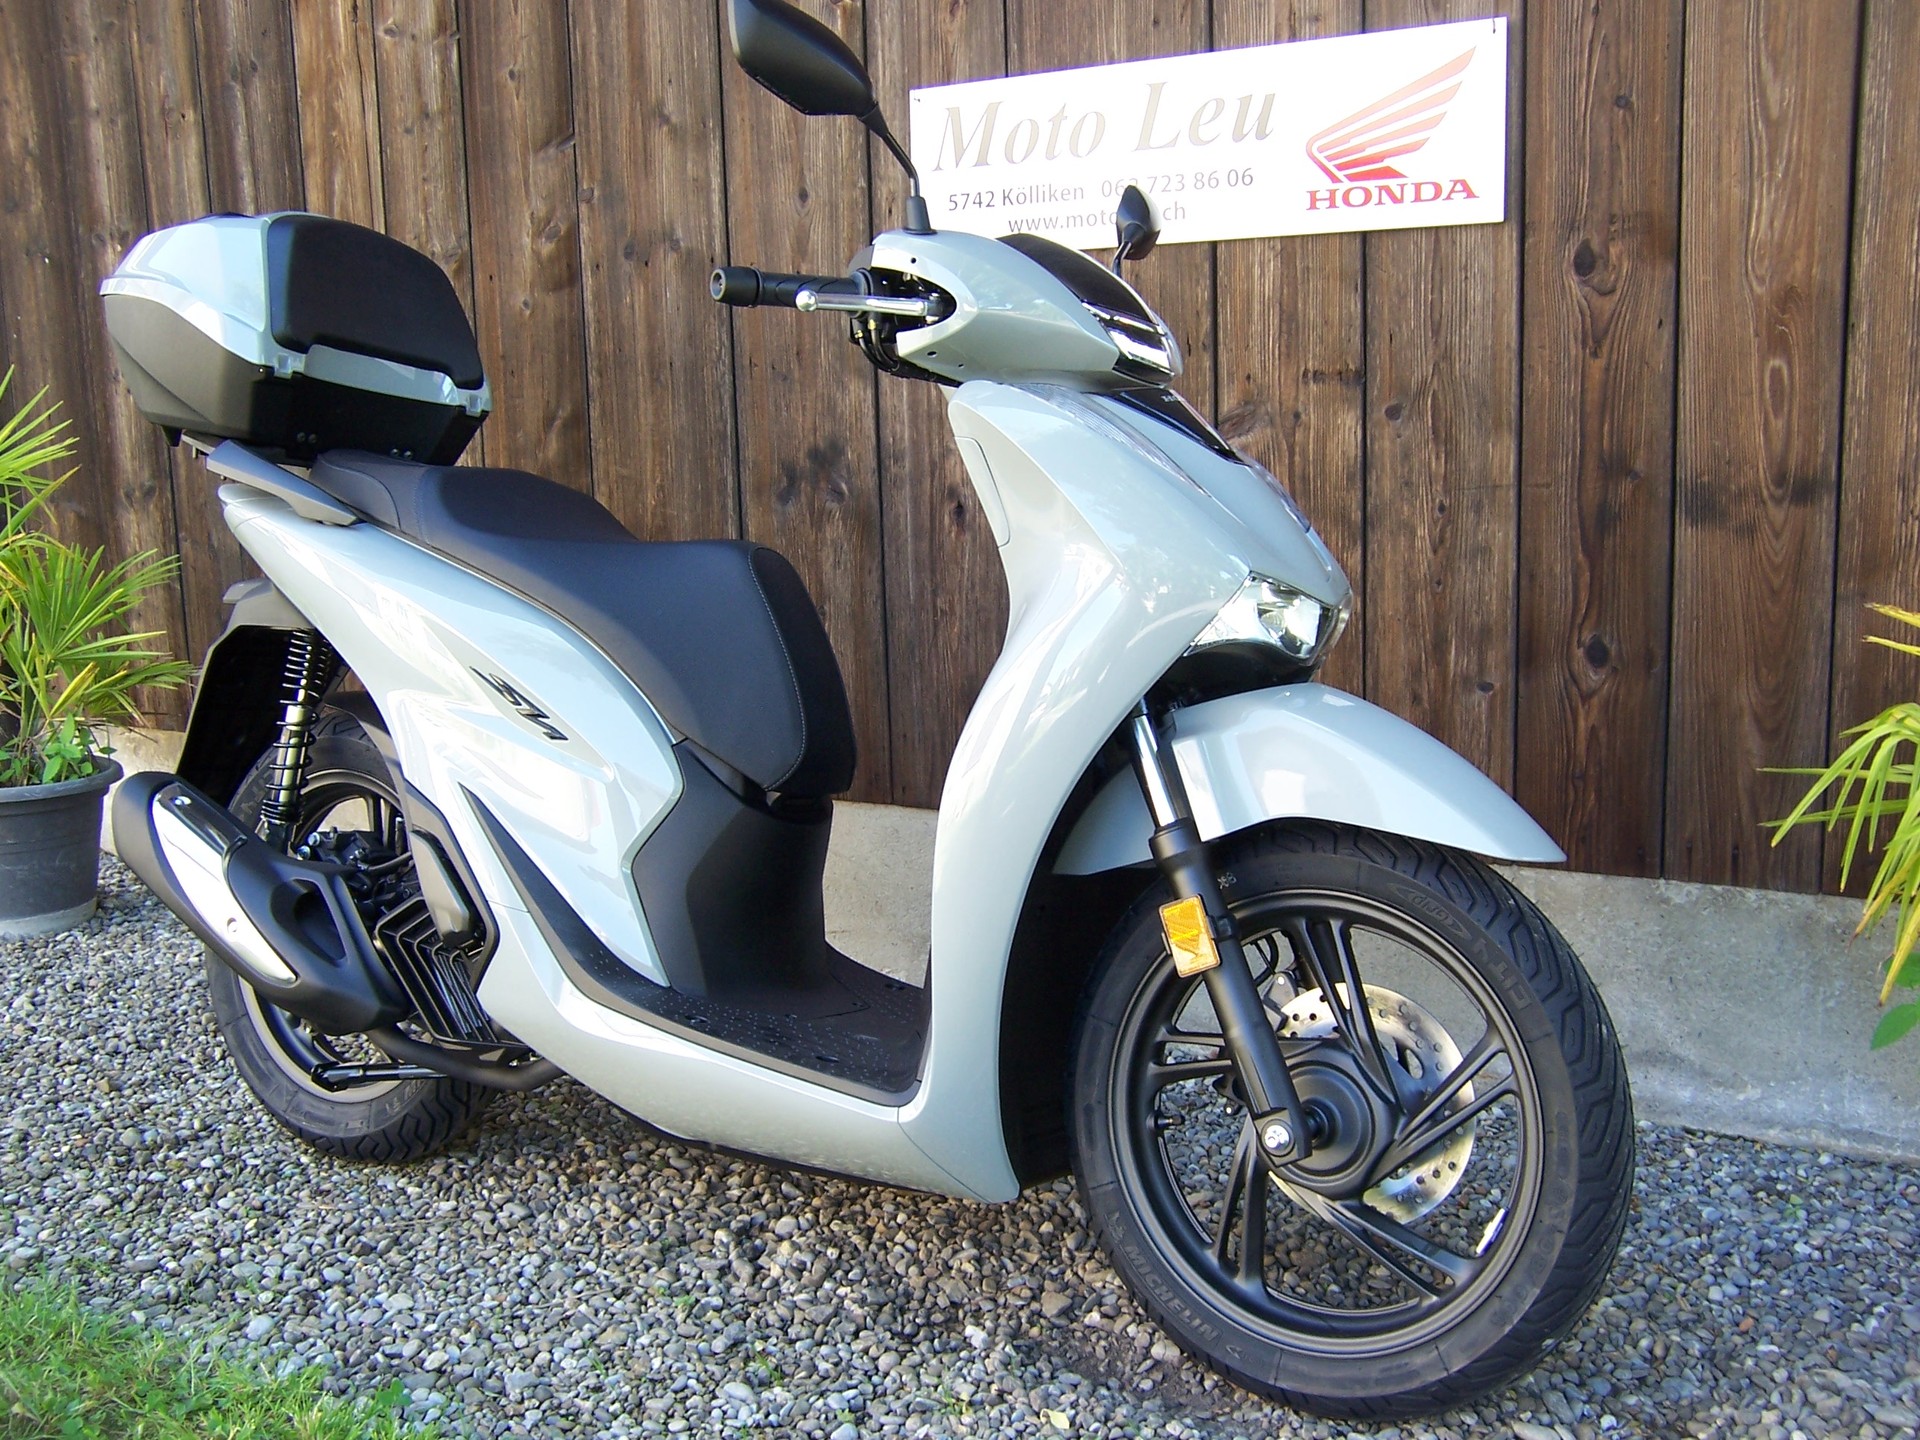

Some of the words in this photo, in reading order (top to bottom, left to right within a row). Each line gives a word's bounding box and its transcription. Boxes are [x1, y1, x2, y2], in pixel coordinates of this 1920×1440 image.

[932, 101, 1106, 171] Moto
[1132, 81, 1276, 152] Leu
[948, 190, 996, 211] 5742
[1002, 184, 1084, 206] Kölliken
[1147, 174, 1185, 194] 723
[1193, 171, 1219, 190] 86
[1227, 168, 1254, 187] 06
[1306, 179, 1480, 210] HONDA
[1126, 1245, 1224, 1342] MICHELIN
